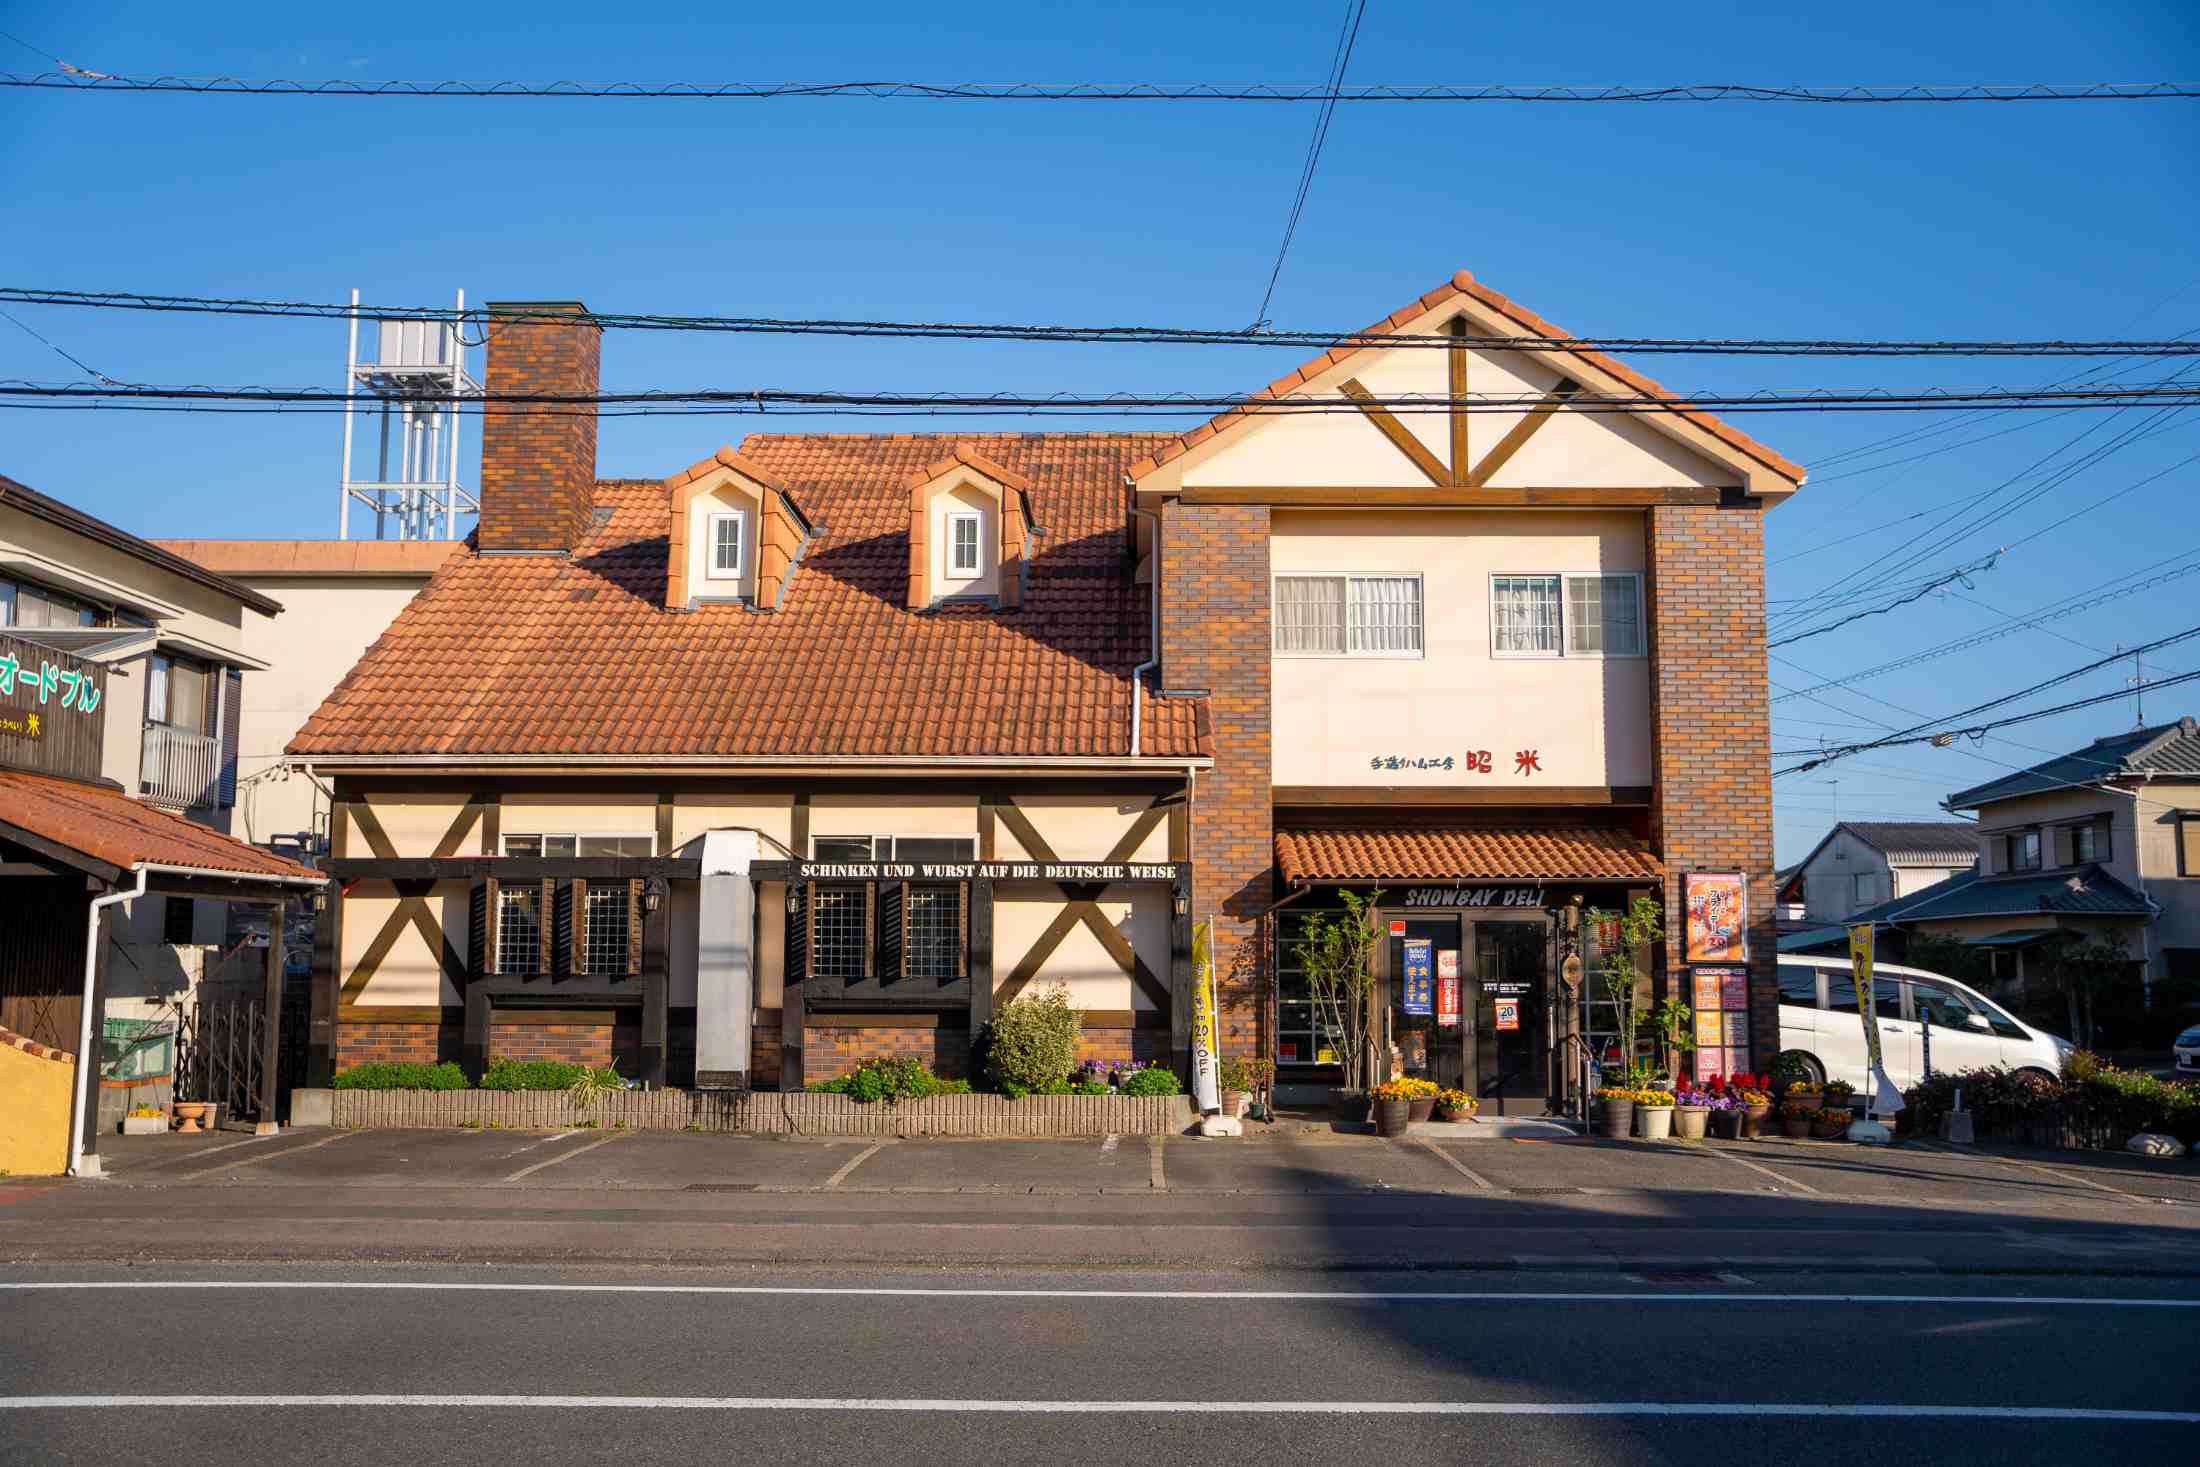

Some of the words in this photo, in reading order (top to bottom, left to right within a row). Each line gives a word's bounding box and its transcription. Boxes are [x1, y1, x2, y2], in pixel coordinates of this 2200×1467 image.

[0, 651, 101, 714] オードブル
[800, 864, 878, 878] SCHINKEN
[883, 865, 915, 878] UND
[922, 865, 976, 878] WURST
[978, 865, 1009, 878] AUF
[1012, 865, 1039, 878] DIE
[1045, 865, 1124, 879] DEUTSCHE
[1129, 866, 1177, 879] WEISE
[1405, 888, 1498, 907] SHOWBAY
[1502, 889, 1545, 906] DELI
